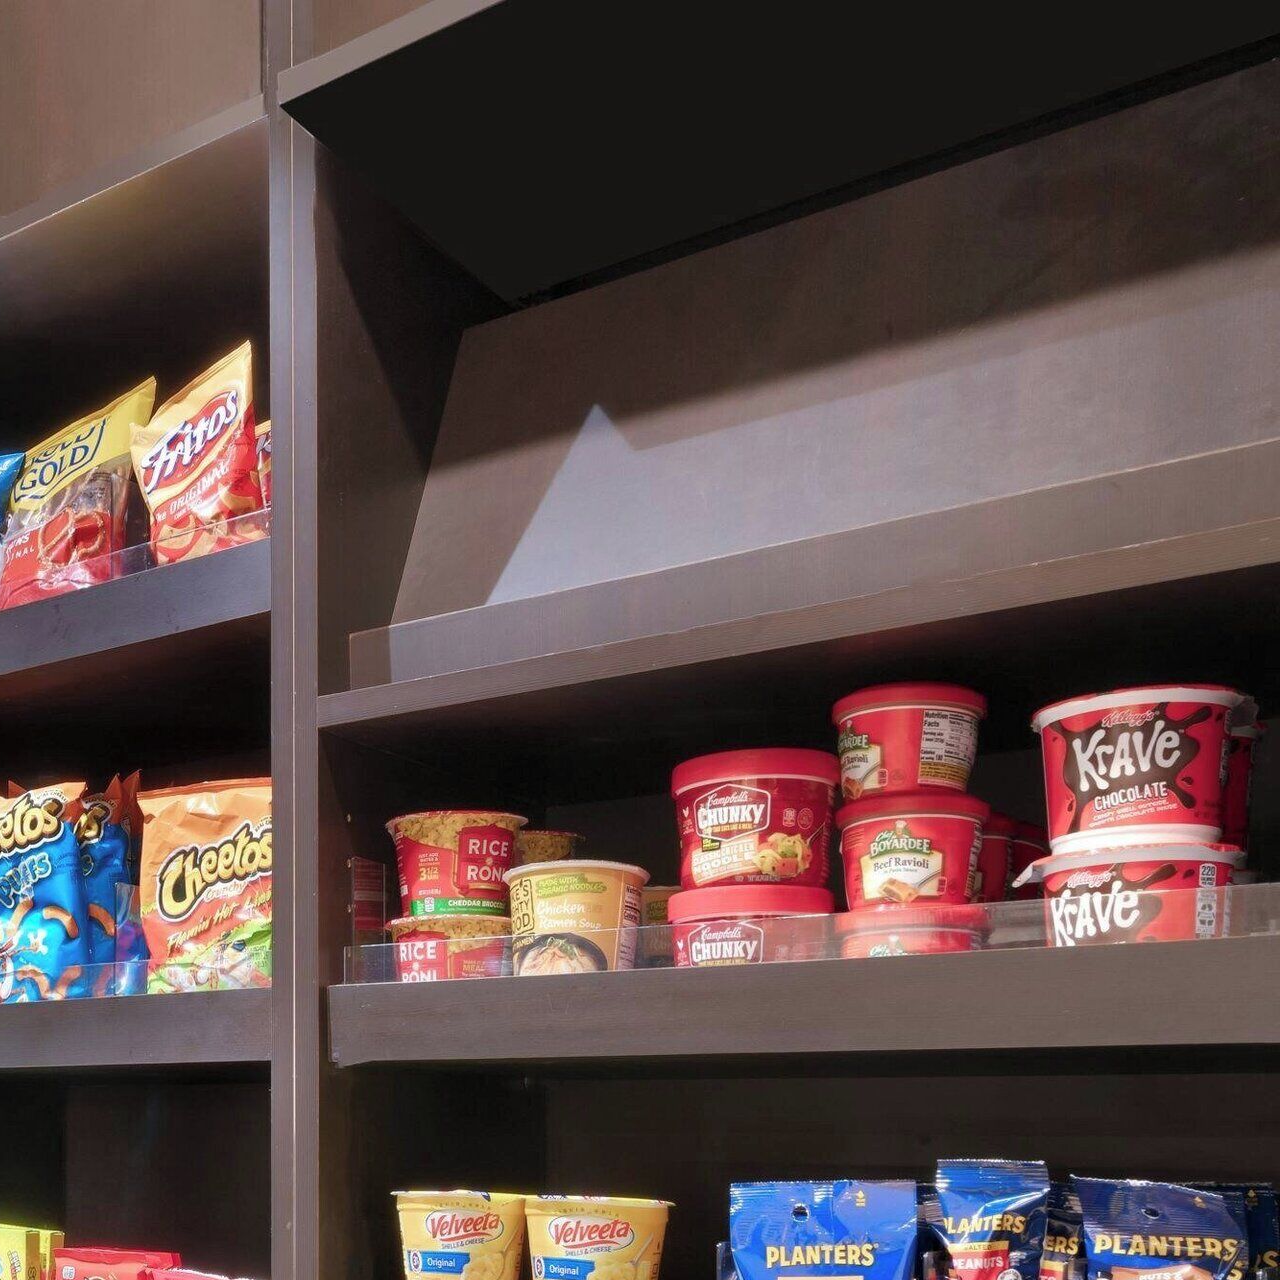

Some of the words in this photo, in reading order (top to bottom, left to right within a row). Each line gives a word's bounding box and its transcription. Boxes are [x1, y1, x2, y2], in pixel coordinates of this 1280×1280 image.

[141, 390, 239, 495] Fritos
[20, 445, 90, 492] GOLD
[923, 719, 941, 729] Facts
[1101, 709, 1157, 728] Kellogg's
[707, 791, 750, 807] Campbell's
[1093, 781, 1169, 812] CHOCOLATE
[697, 802, 765, 830] CHUNKY
[468, 838, 509, 857] RICE
[869, 838, 931, 857] BOYARDEE
[159, 822, 272, 920] Cheetos
[467, 865, 507, 882] RONI
[873, 858, 894, 872] Beef
[894, 856, 930, 869] Ravioli
[1066, 871, 1112, 888] Kellogg's
[448, 899, 481, 908] CHEDDAR
[536, 898, 587, 915] Chicken
[539, 917, 577, 930] Ramen
[701, 925, 743, 941] Campbell's
[399, 940, 438, 963] RICE
[691, 940, 758, 963] CHUNKY
[430, 1210, 500, 1239] Velveeta
[552, 1218, 632, 1246] Velveeta
[766, 1243, 875, 1269] PLANTERS
[1092, 1233, 1241, 1262] PLANTERS
[426, 1256, 456, 1268] Original
[549, 1264, 580, 1276] Original
[952, 1256, 1005, 1270] PEANUTS
[1138, 1272, 1171, 1280] NUTS
